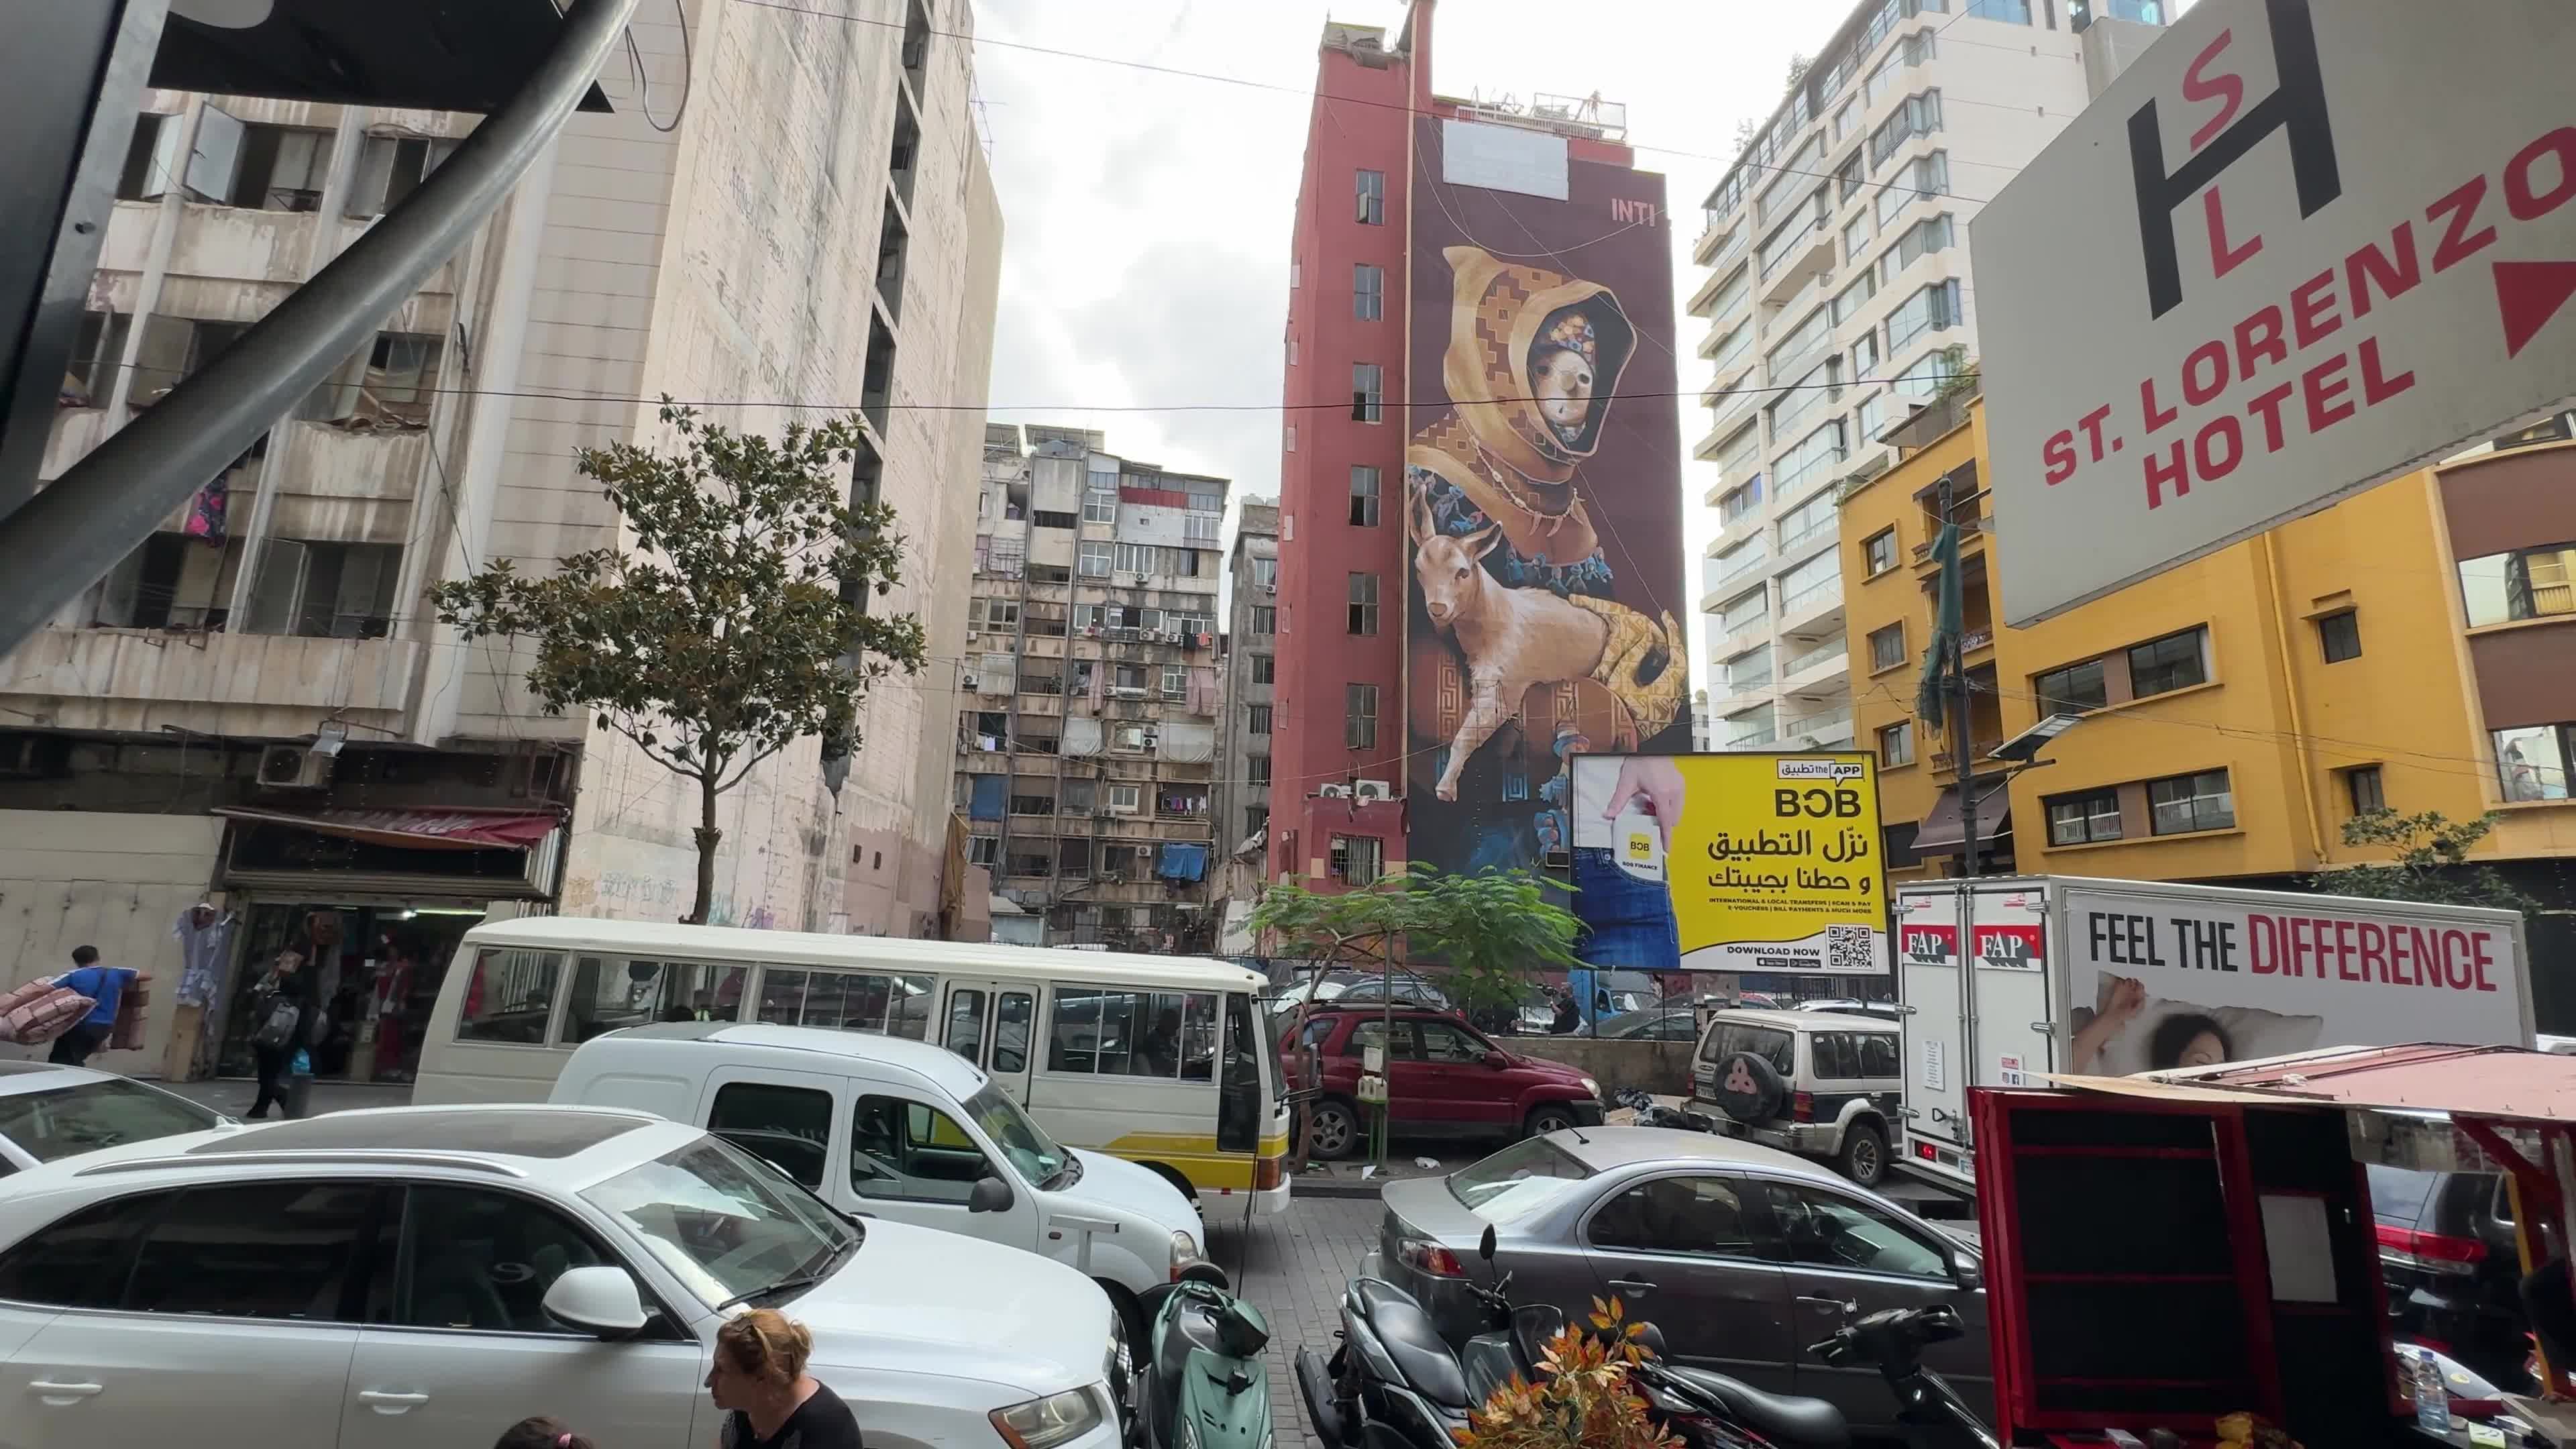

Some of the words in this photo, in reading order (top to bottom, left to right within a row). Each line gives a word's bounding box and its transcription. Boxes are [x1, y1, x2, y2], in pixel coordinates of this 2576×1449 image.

[1611, 198, 1655, 227] INTI
[2043, 404, 2124, 486] ST.
[2140, 126, 2576, 435] LORENZO
[2143, 336, 2416, 510] HOTEL
[1782, 764, 1815, 776] تطبيق
[1815, 765, 1828, 773] the
[1834, 766, 1860, 774] APP
[1707, 828, 1812, 862] التطبيق
[1708, 866, 1789, 894] بجيبتك
[1796, 867, 1851, 890] حطنا
[1859, 876, 1871, 896] و
[1727, 946, 1790, 956] DOWNLOAD
[1793, 948, 1821, 957] NOW
[1906, 929, 1943, 956] FAP
[1980, 930, 2023, 959] FAP
[2088, 912, 2166, 967] FEEL
[2171, 918, 2239, 972] THE
[2247, 914, 2498, 992] DIFFERENCE
